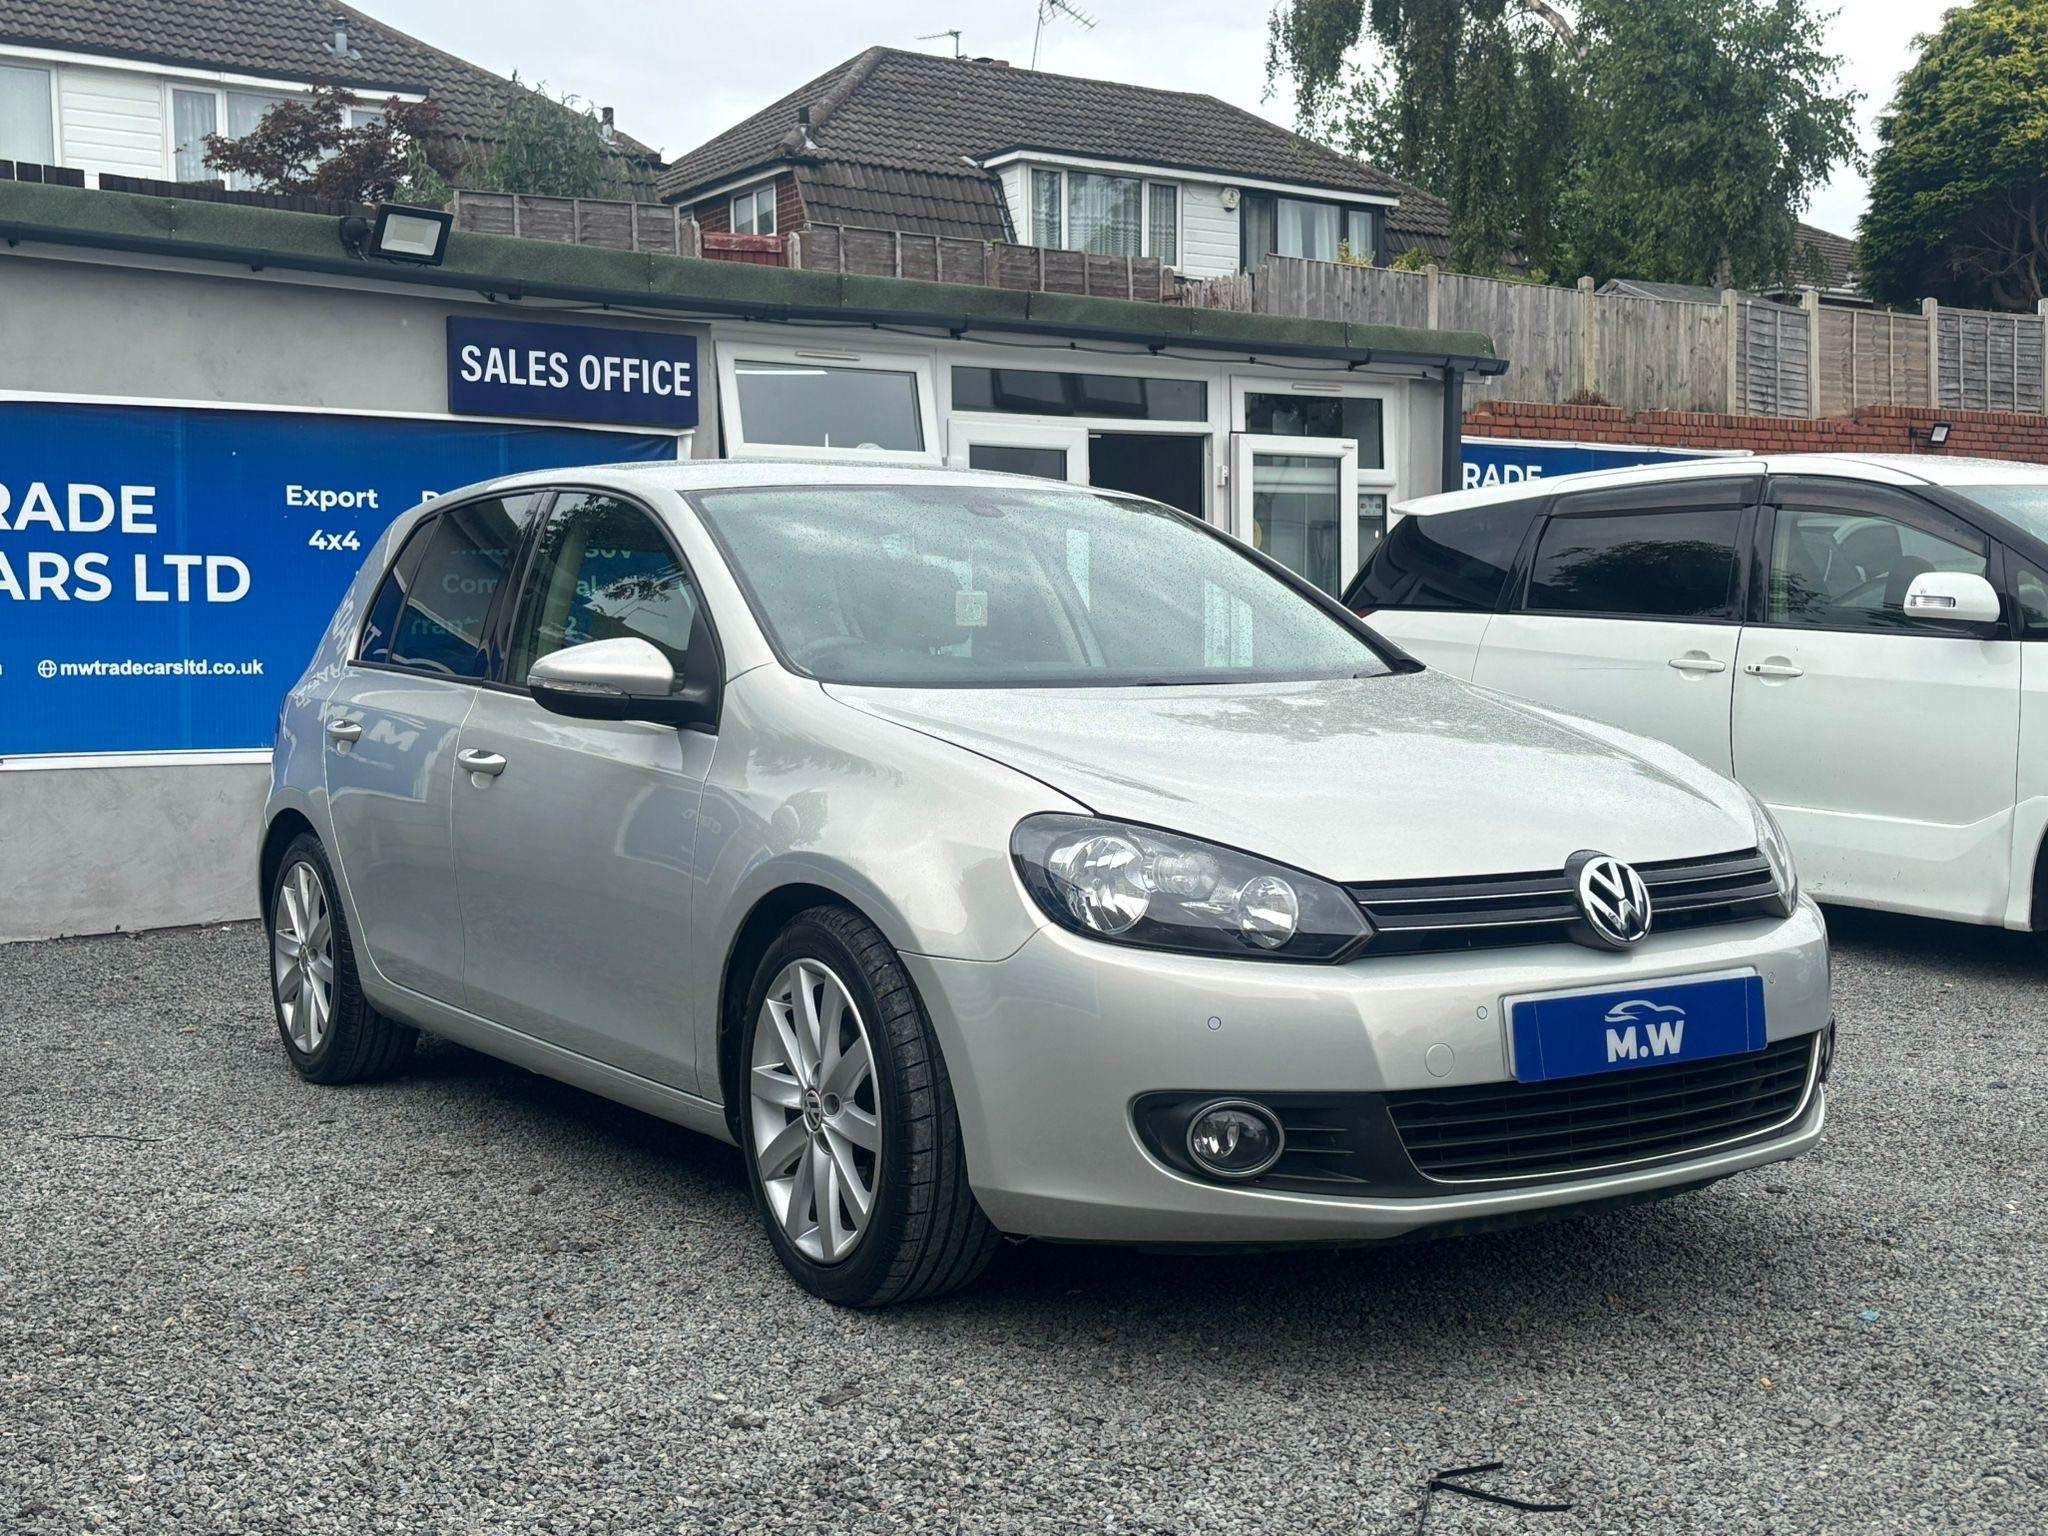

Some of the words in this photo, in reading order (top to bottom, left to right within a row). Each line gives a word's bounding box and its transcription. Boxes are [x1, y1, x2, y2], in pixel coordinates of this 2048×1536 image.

[460, 344, 569, 388] SALES
[579, 354, 692, 397] OFFICE
[286, 484, 379, 512] Export
[308, 529, 361, 551] 4x4
[134, 553, 251, 603] LTD
[60, 659, 264, 676] mwtradecarsltd.co.uk
[1606, 1020, 1685, 1063] M.W
